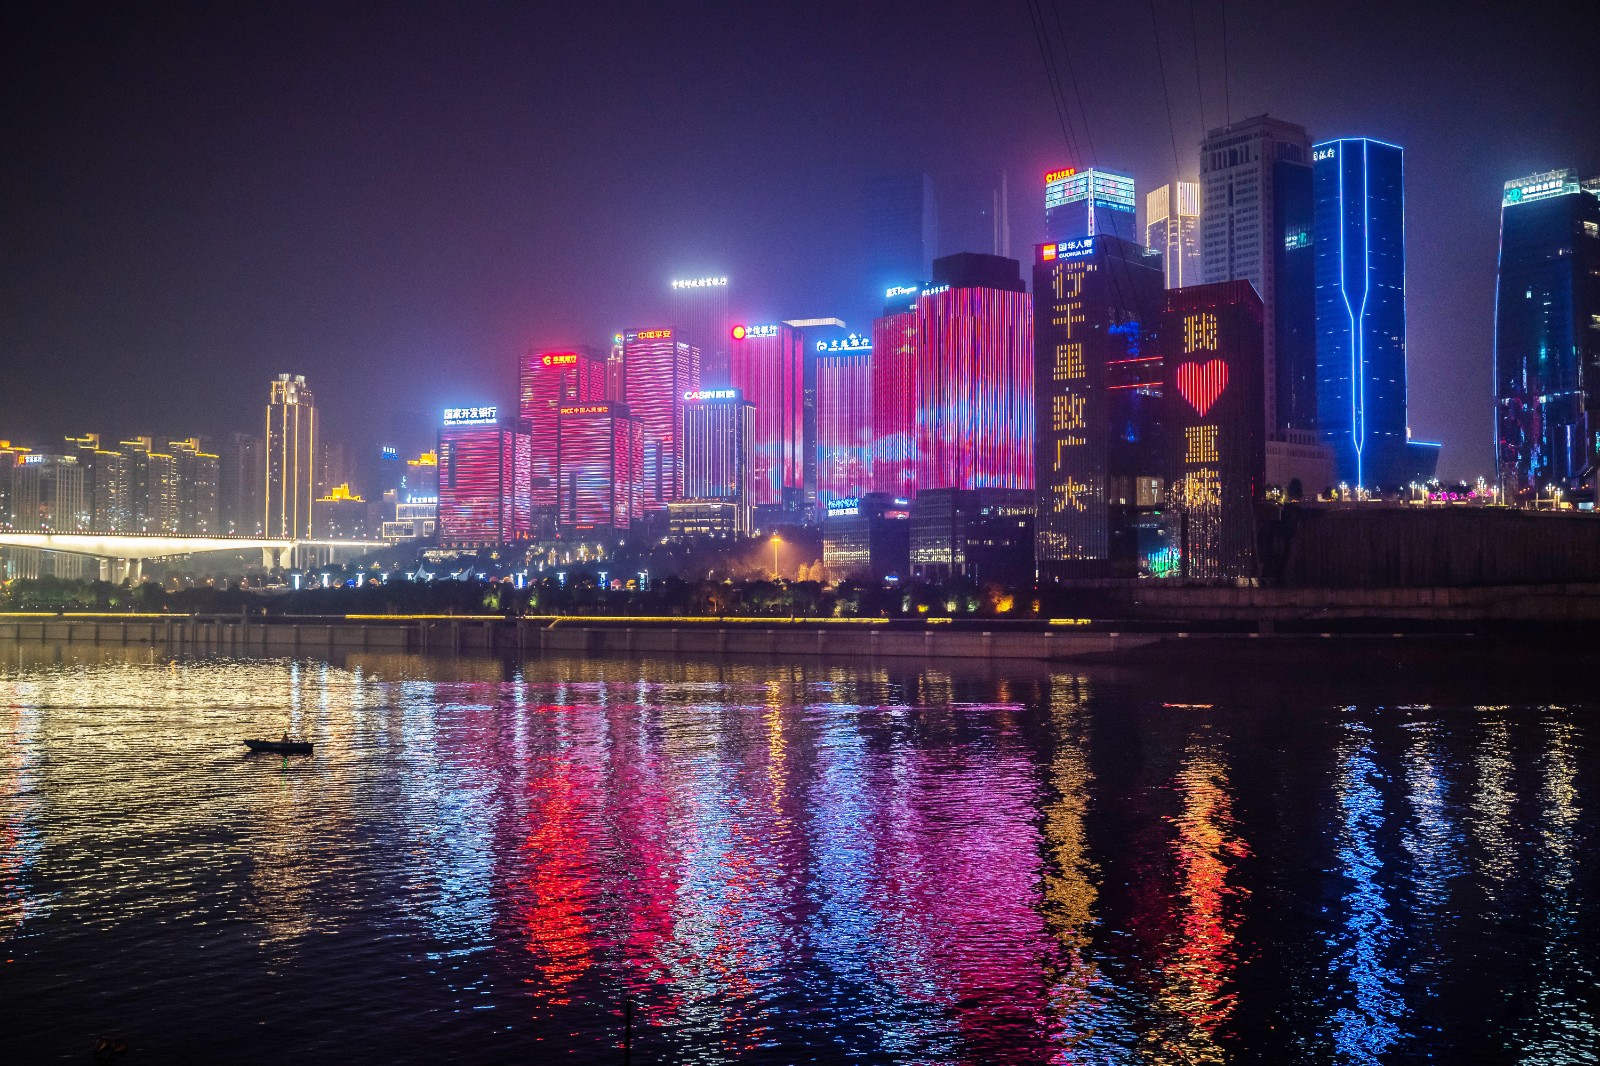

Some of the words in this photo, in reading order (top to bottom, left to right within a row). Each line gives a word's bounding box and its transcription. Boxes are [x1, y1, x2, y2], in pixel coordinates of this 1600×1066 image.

[1058, 239, 1093, 251] 国华人寿
[638, 330, 671, 339] 中国平安
[745, 325, 777, 336] 中信银行
[684, 390, 715, 399] CASIN
[444, 406, 497, 419] 国家开发银行
